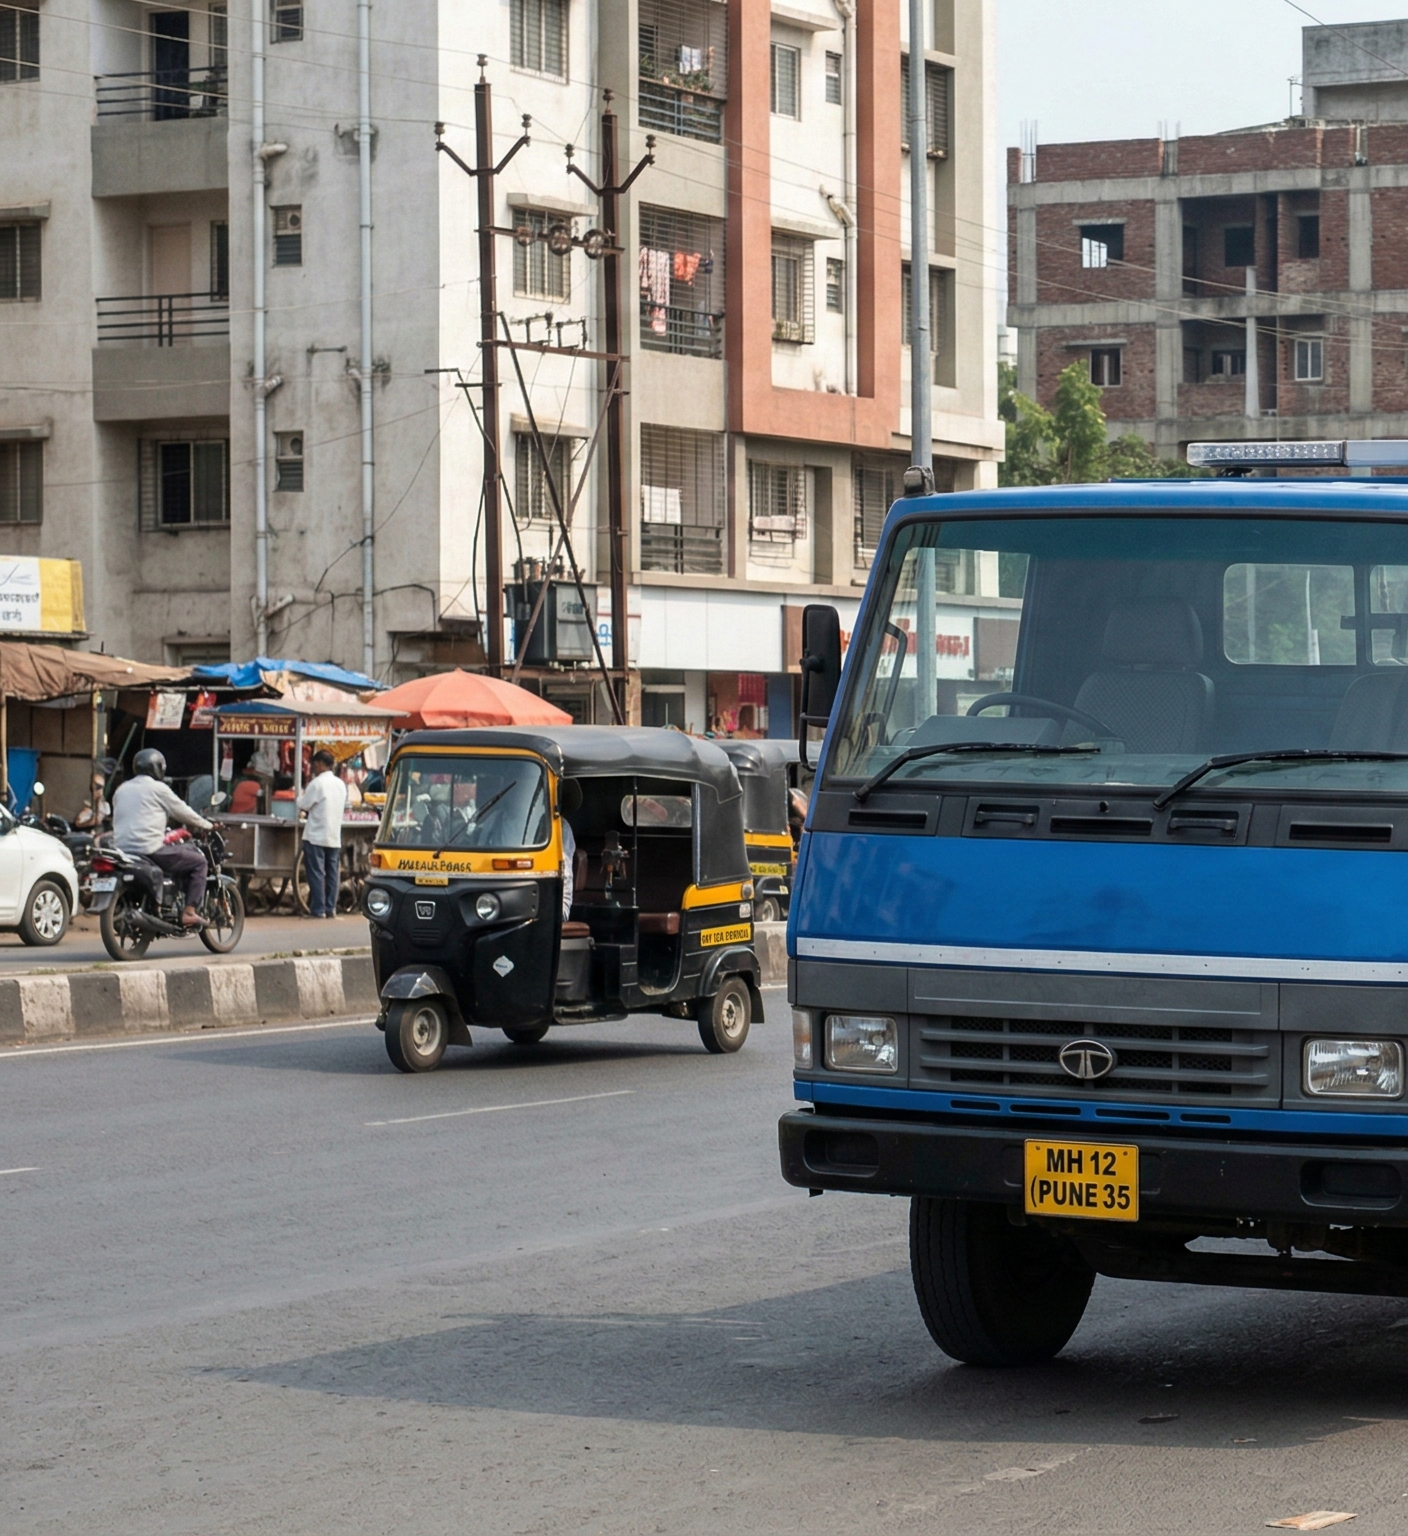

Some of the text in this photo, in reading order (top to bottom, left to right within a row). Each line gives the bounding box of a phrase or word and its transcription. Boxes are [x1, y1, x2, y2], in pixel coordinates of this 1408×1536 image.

[1046, 1148, 1117, 1176] MH 12
[1030, 1175, 1130, 1210] (PUNE 35
